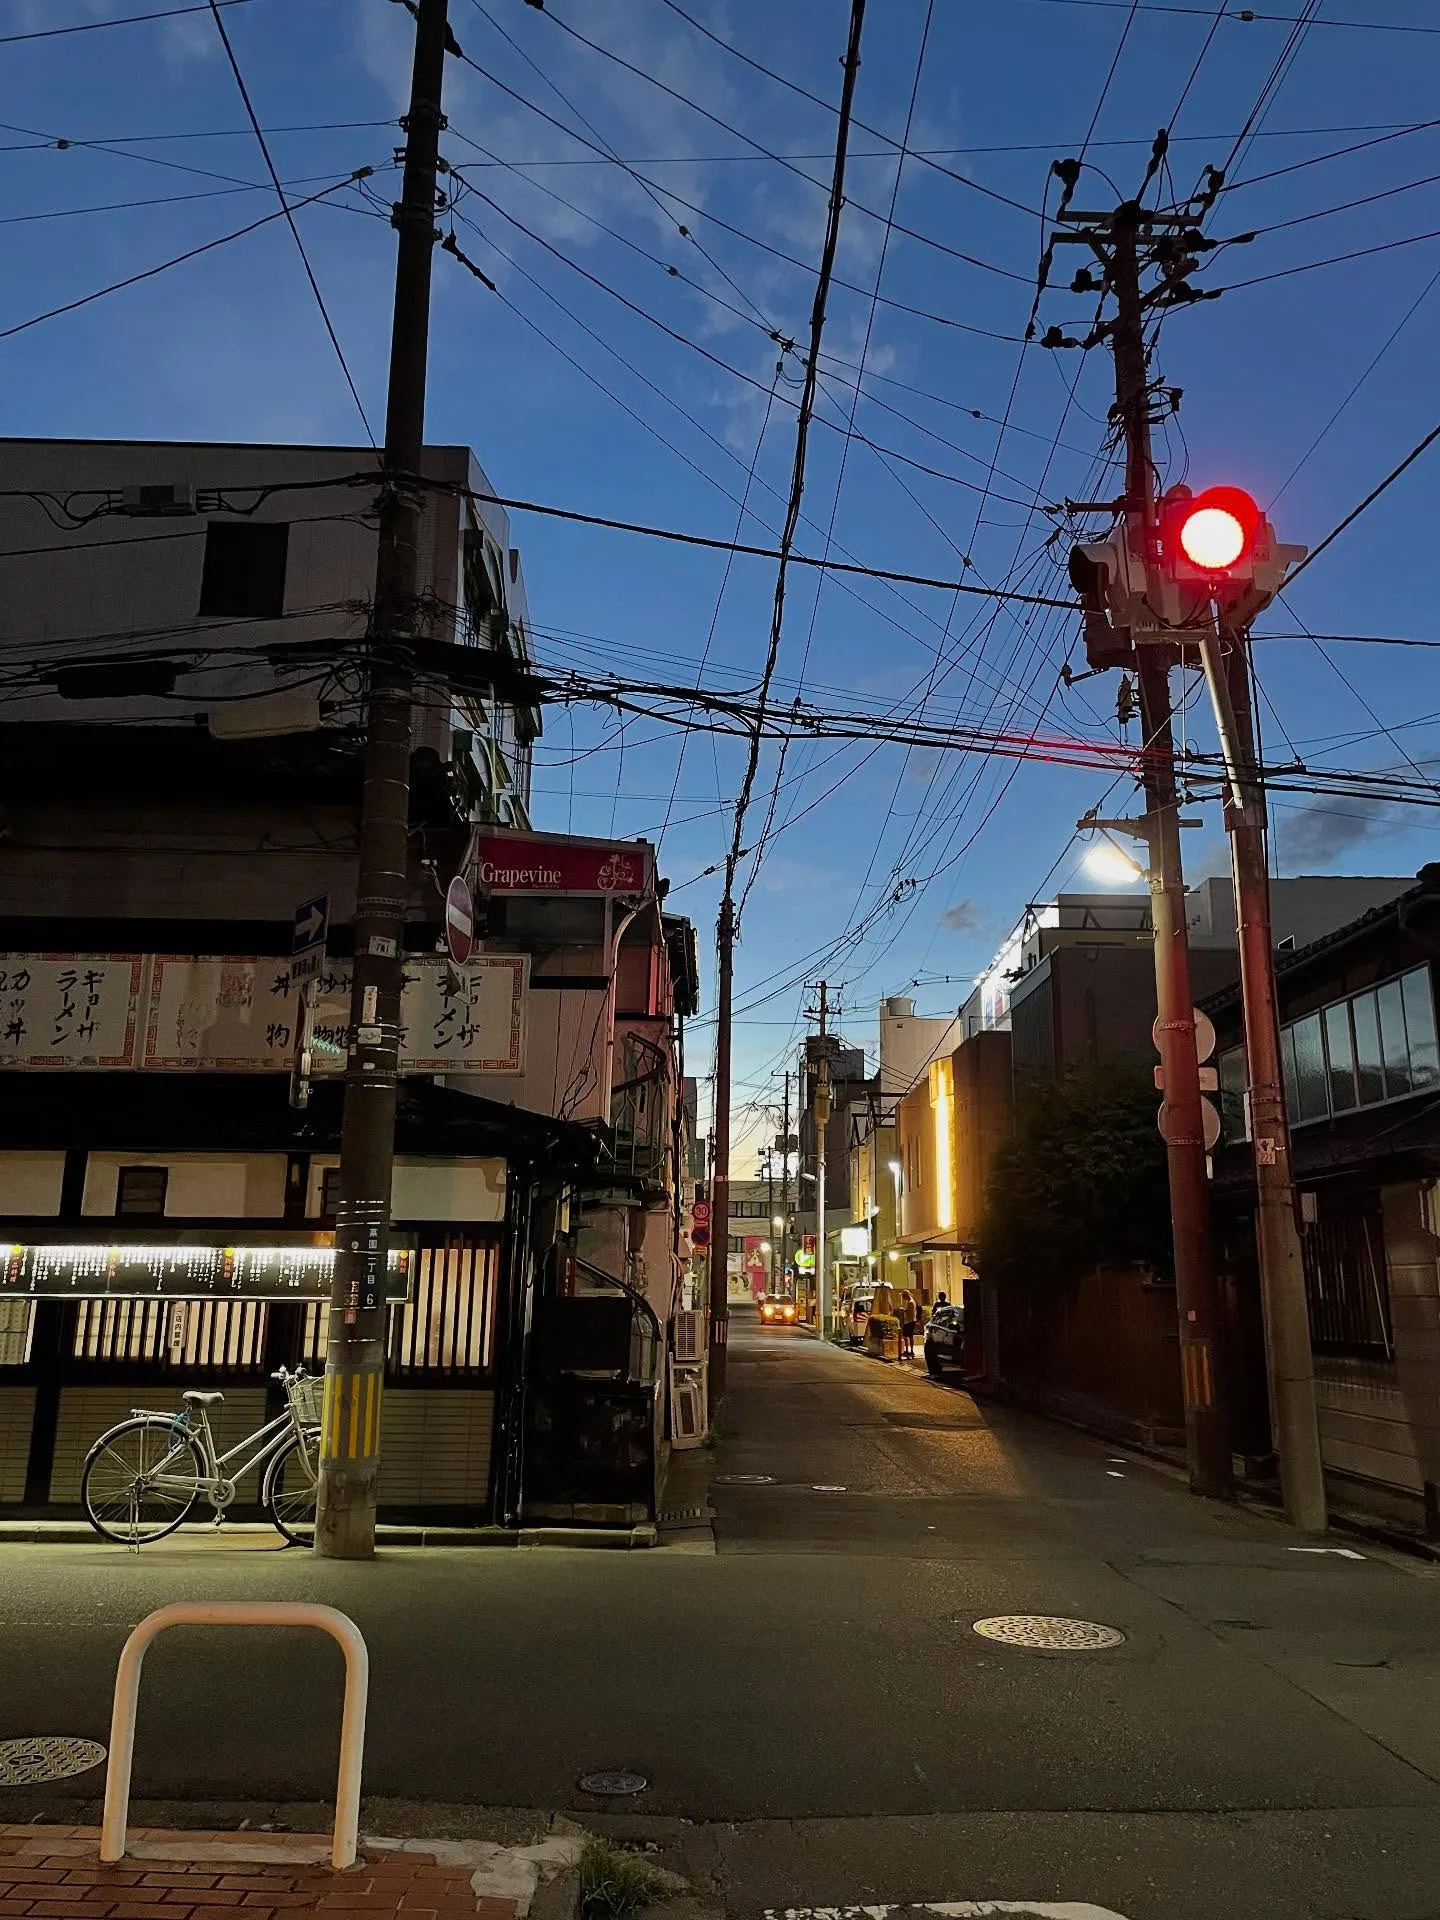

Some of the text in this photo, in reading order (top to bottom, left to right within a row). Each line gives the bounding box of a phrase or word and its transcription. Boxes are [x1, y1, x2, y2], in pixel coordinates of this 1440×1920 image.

[481, 862, 562, 888] Grapevine
[51, 970, 78, 1045] ラーメン
[77, 970, 105, 1042] ギョーザ
[696, 1206, 707, 1216] 30
[366, 1293, 374, 1305] 6
